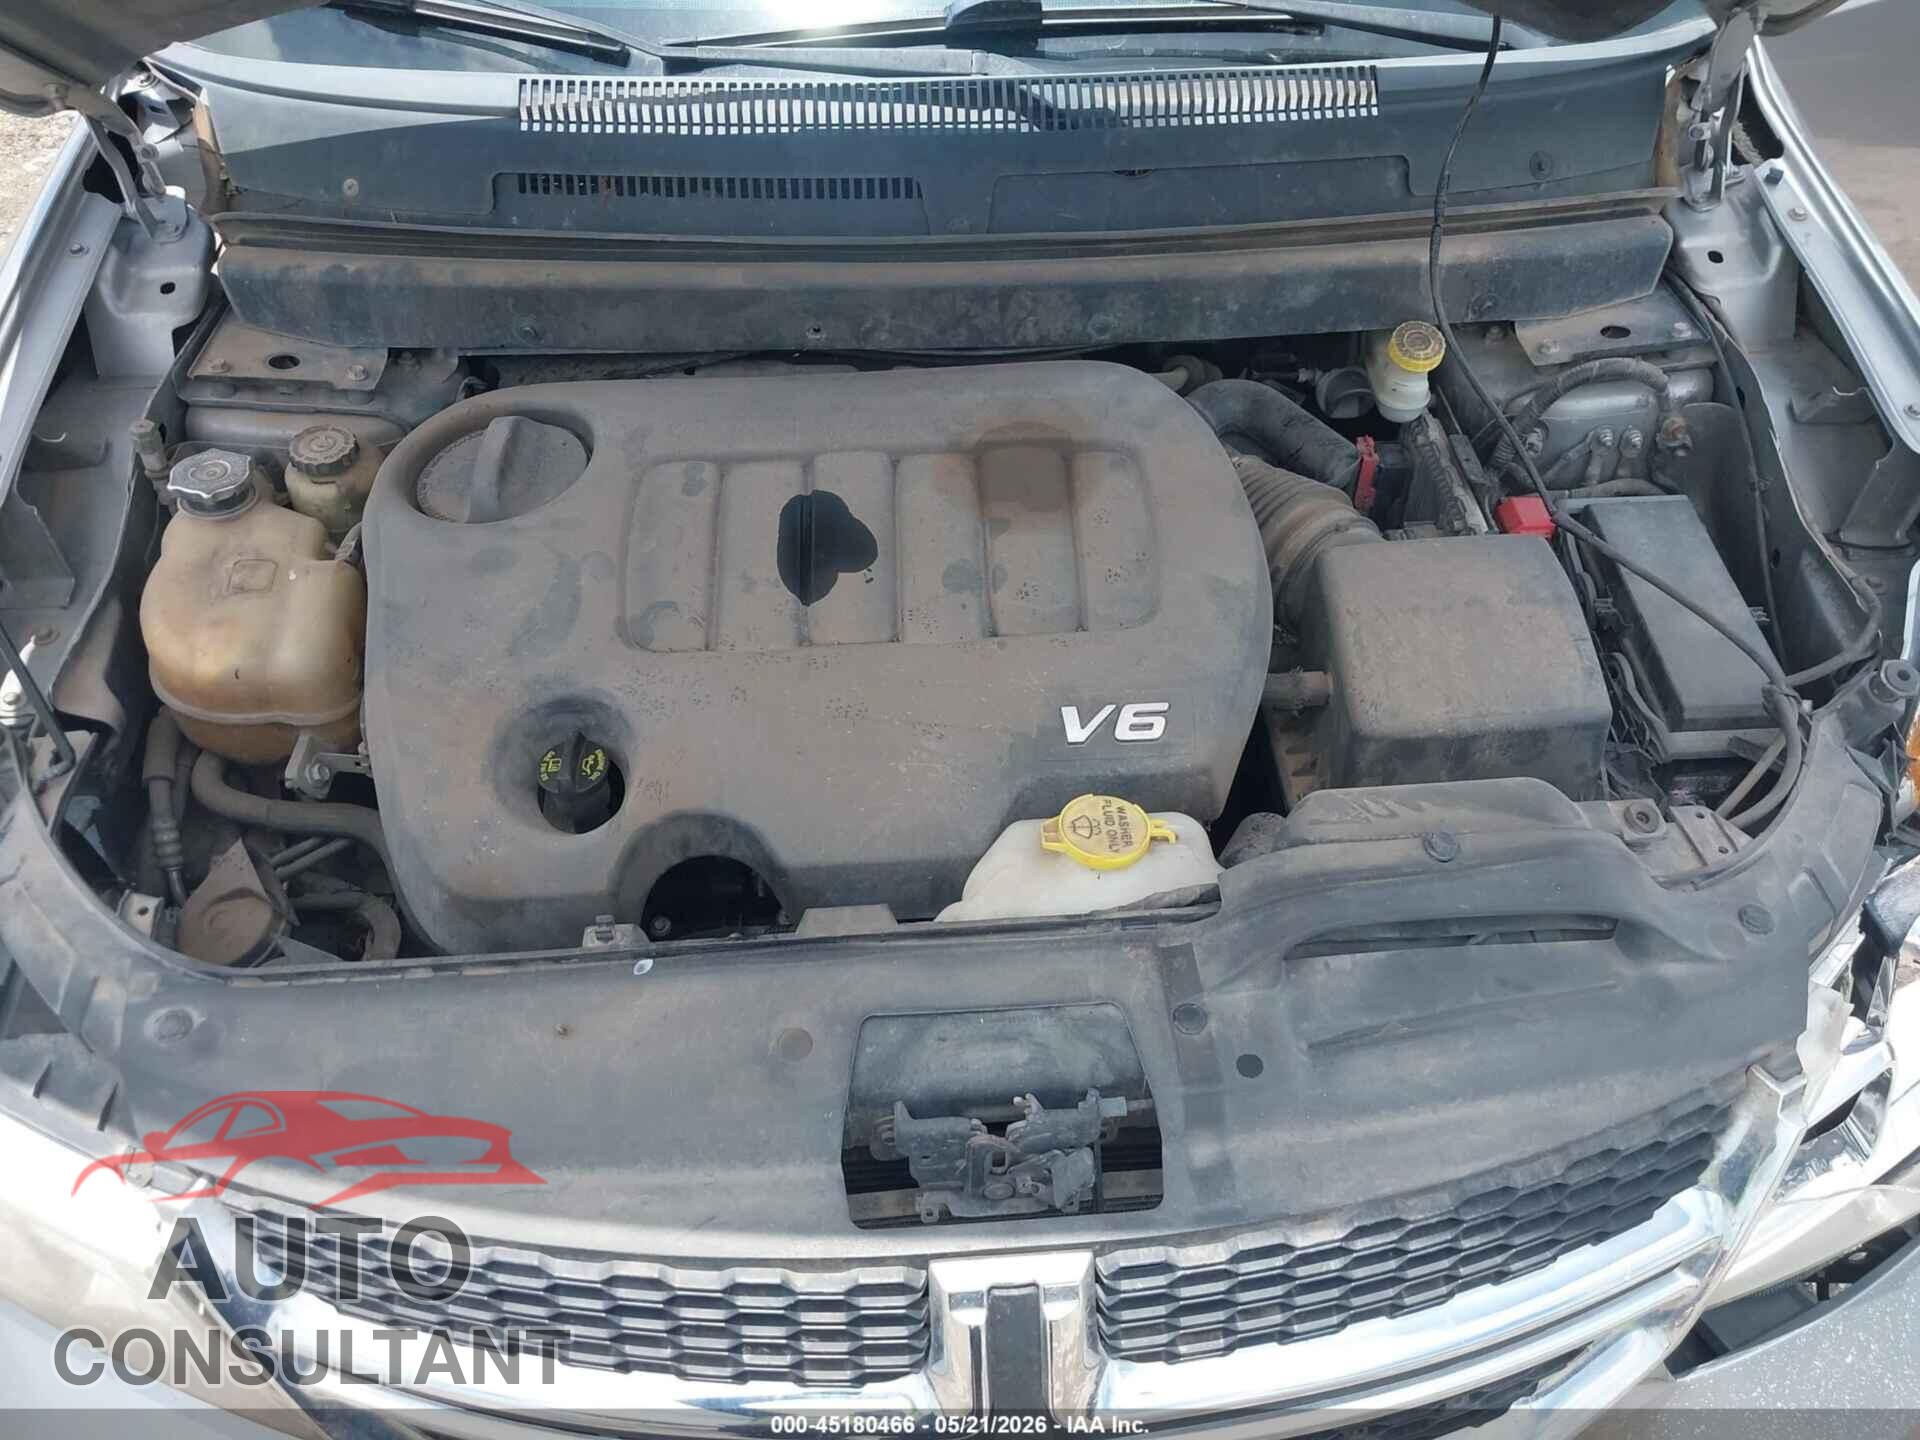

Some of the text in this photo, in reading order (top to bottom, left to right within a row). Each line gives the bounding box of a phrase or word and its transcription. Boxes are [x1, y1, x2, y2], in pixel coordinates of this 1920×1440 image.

[1060, 703, 1170, 744] V6
[1102, 799, 1120, 854] FLUID ONLY
[1116, 806, 1134, 848] WASHER
